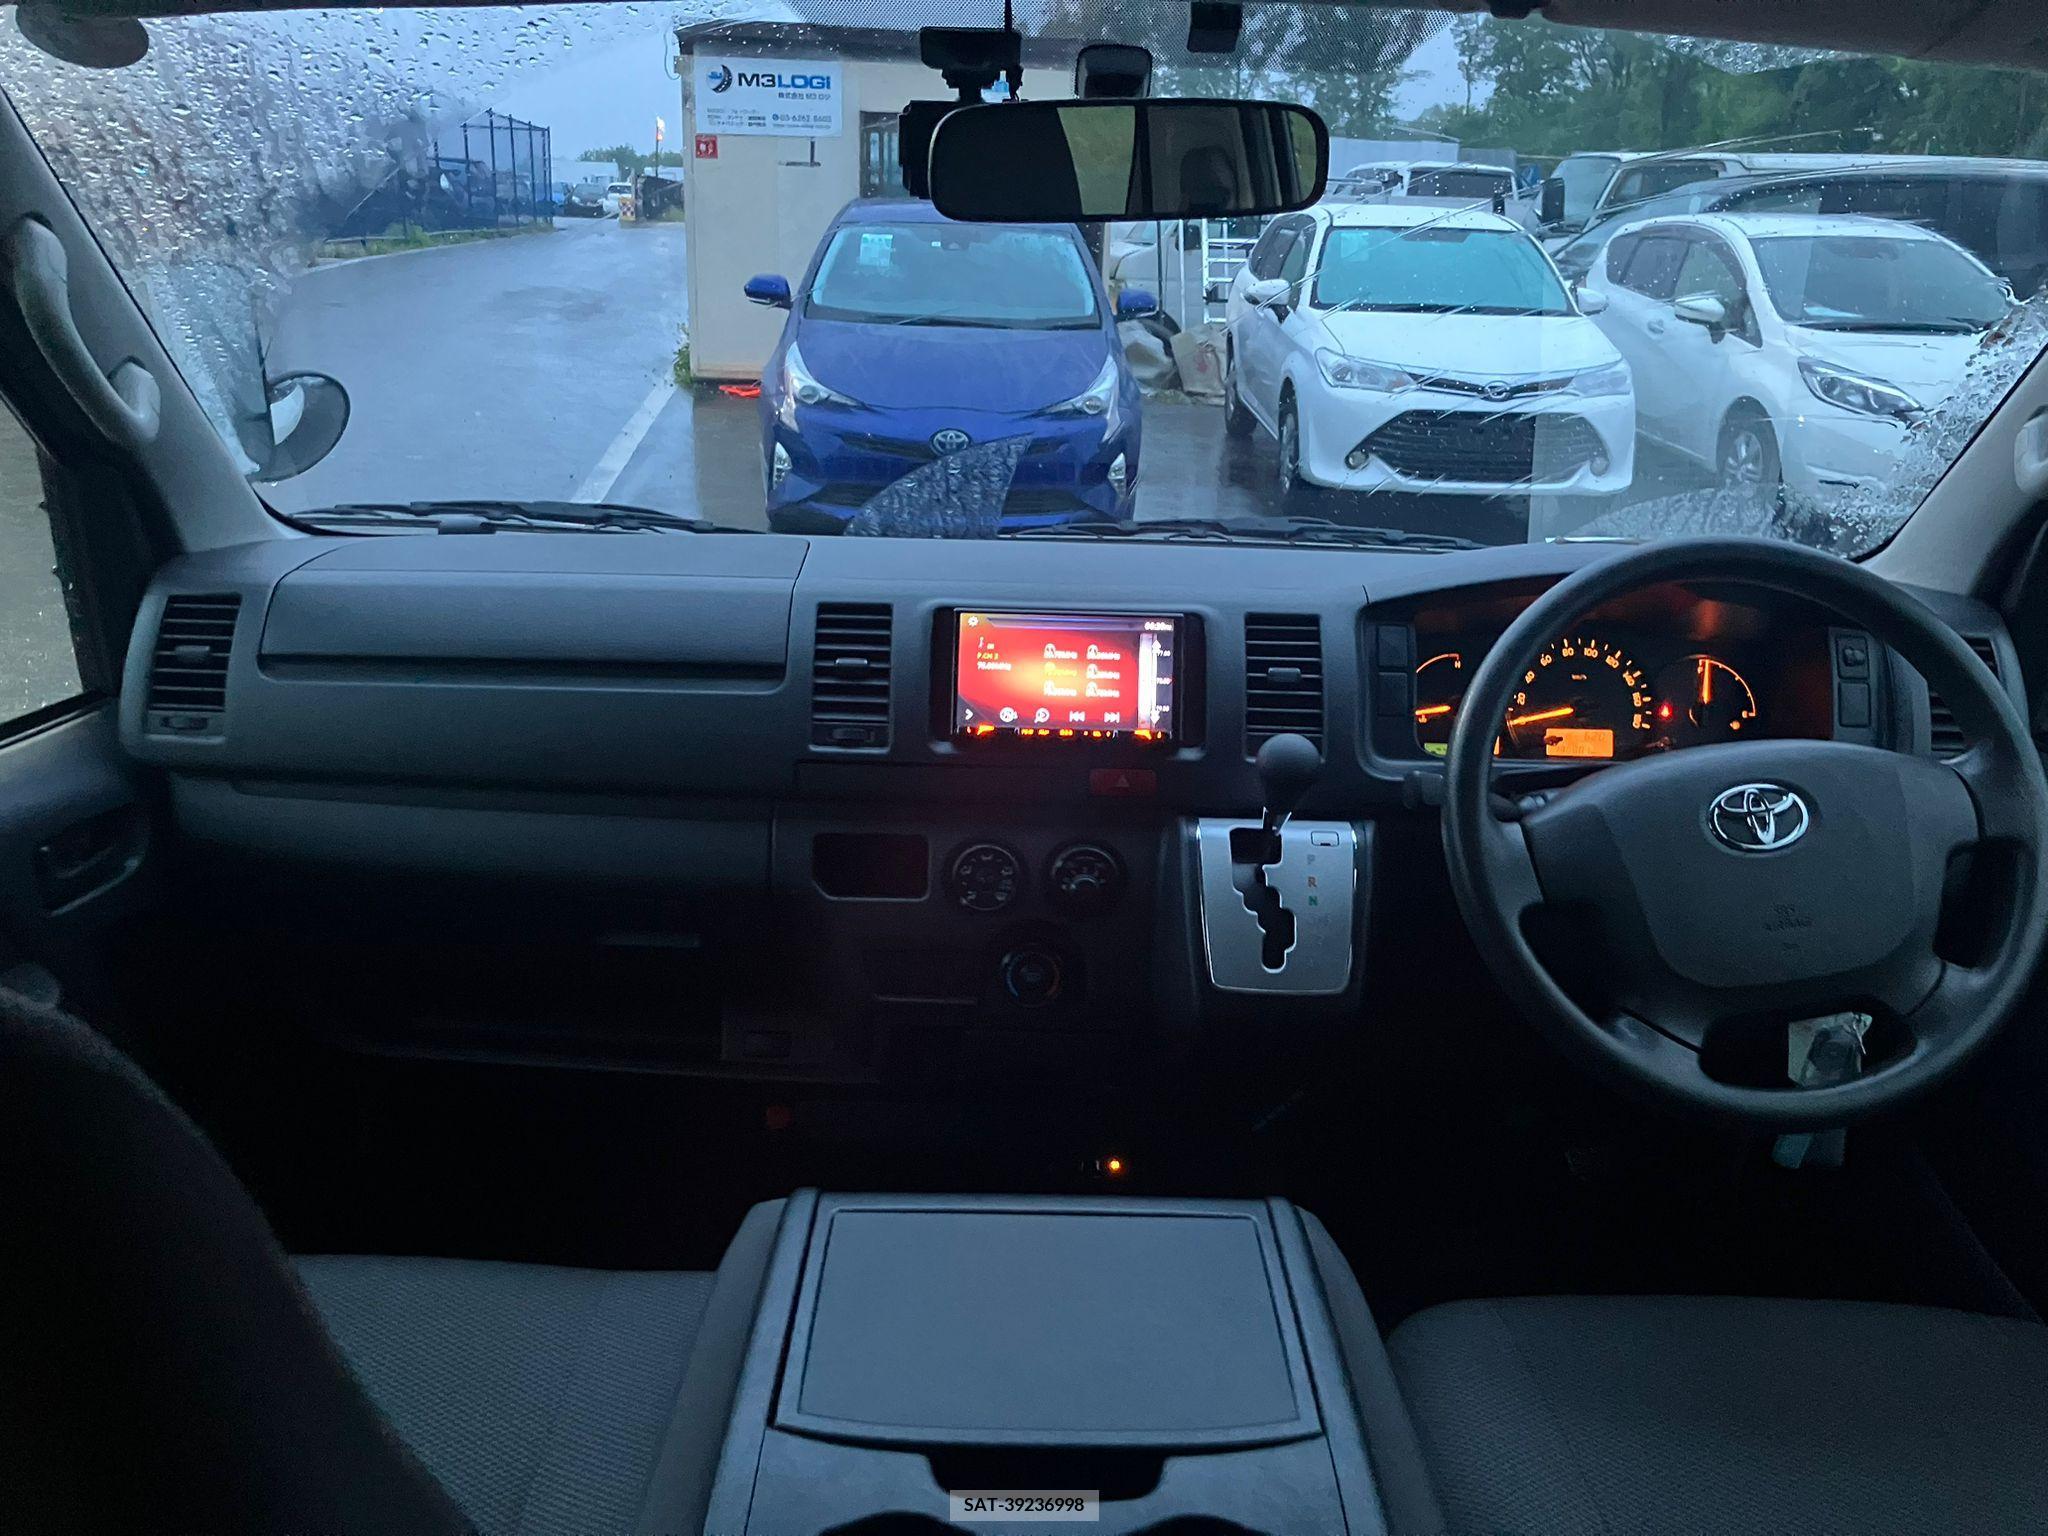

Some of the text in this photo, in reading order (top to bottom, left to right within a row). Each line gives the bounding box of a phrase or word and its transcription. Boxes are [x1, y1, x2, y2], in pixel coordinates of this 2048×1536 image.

[738, 73, 831, 89] M3LOGI
[1562, 647, 1574, 657] 80
[1583, 647, 1599, 658] 100
[1540, 654, 1552, 667] 60
[1308, 877, 1317, 888] R
[1308, 896, 1318, 906] N
